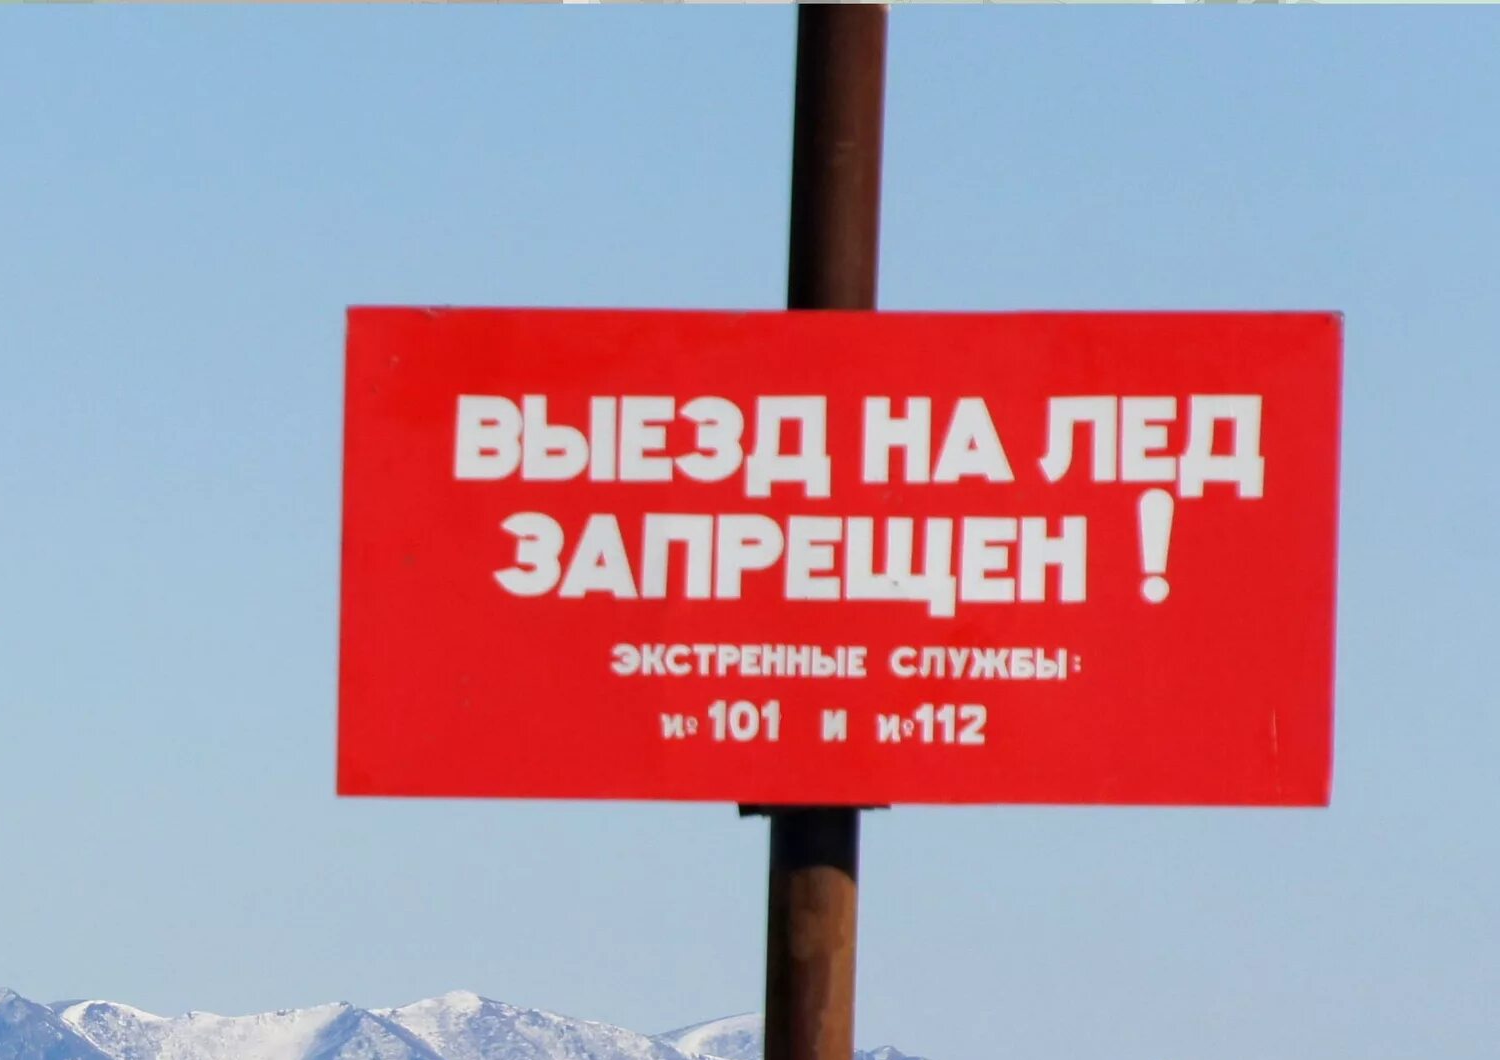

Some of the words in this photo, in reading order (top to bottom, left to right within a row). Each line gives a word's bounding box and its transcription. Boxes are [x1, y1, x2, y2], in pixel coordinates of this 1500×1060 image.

[454, 394, 832, 499] ВЫЕЗД
[862, 395, 1015, 484] НА
[1038, 394, 1265, 499] ЛЕД
[494, 511, 1088, 618] ЗАПРЕЩЕН
[611, 643, 868, 678] ЭКСТРЕННЫЕ
[889, 646, 1082, 680] СЛУЖБЫ:
